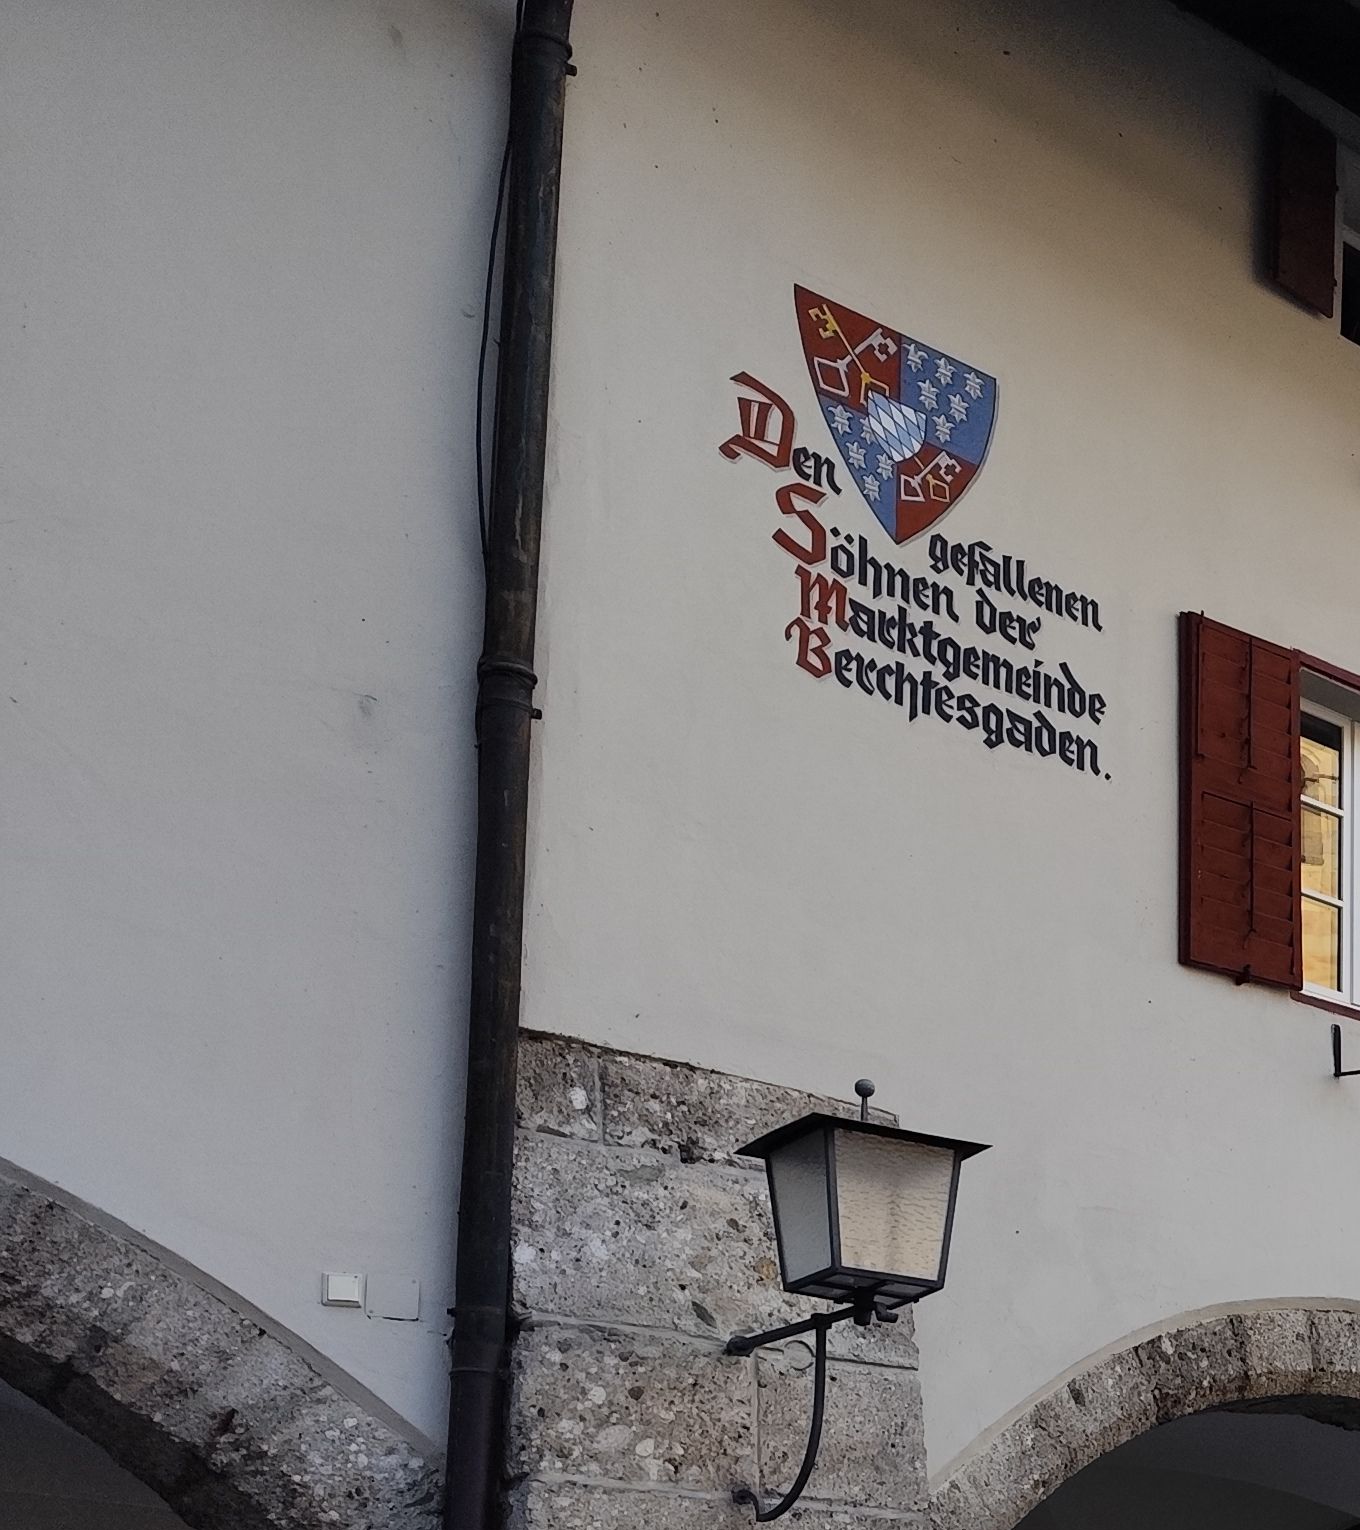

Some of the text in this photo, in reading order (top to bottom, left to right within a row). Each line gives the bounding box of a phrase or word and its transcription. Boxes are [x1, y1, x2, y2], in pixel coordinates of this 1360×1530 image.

[719, 371, 1103, 632] Den gefallenen
[772, 484, 1041, 651] Söhnen der
[785, 617, 1113, 781] Berchtesgaden.
[795, 565, 1107, 725] Marktgemeinde
